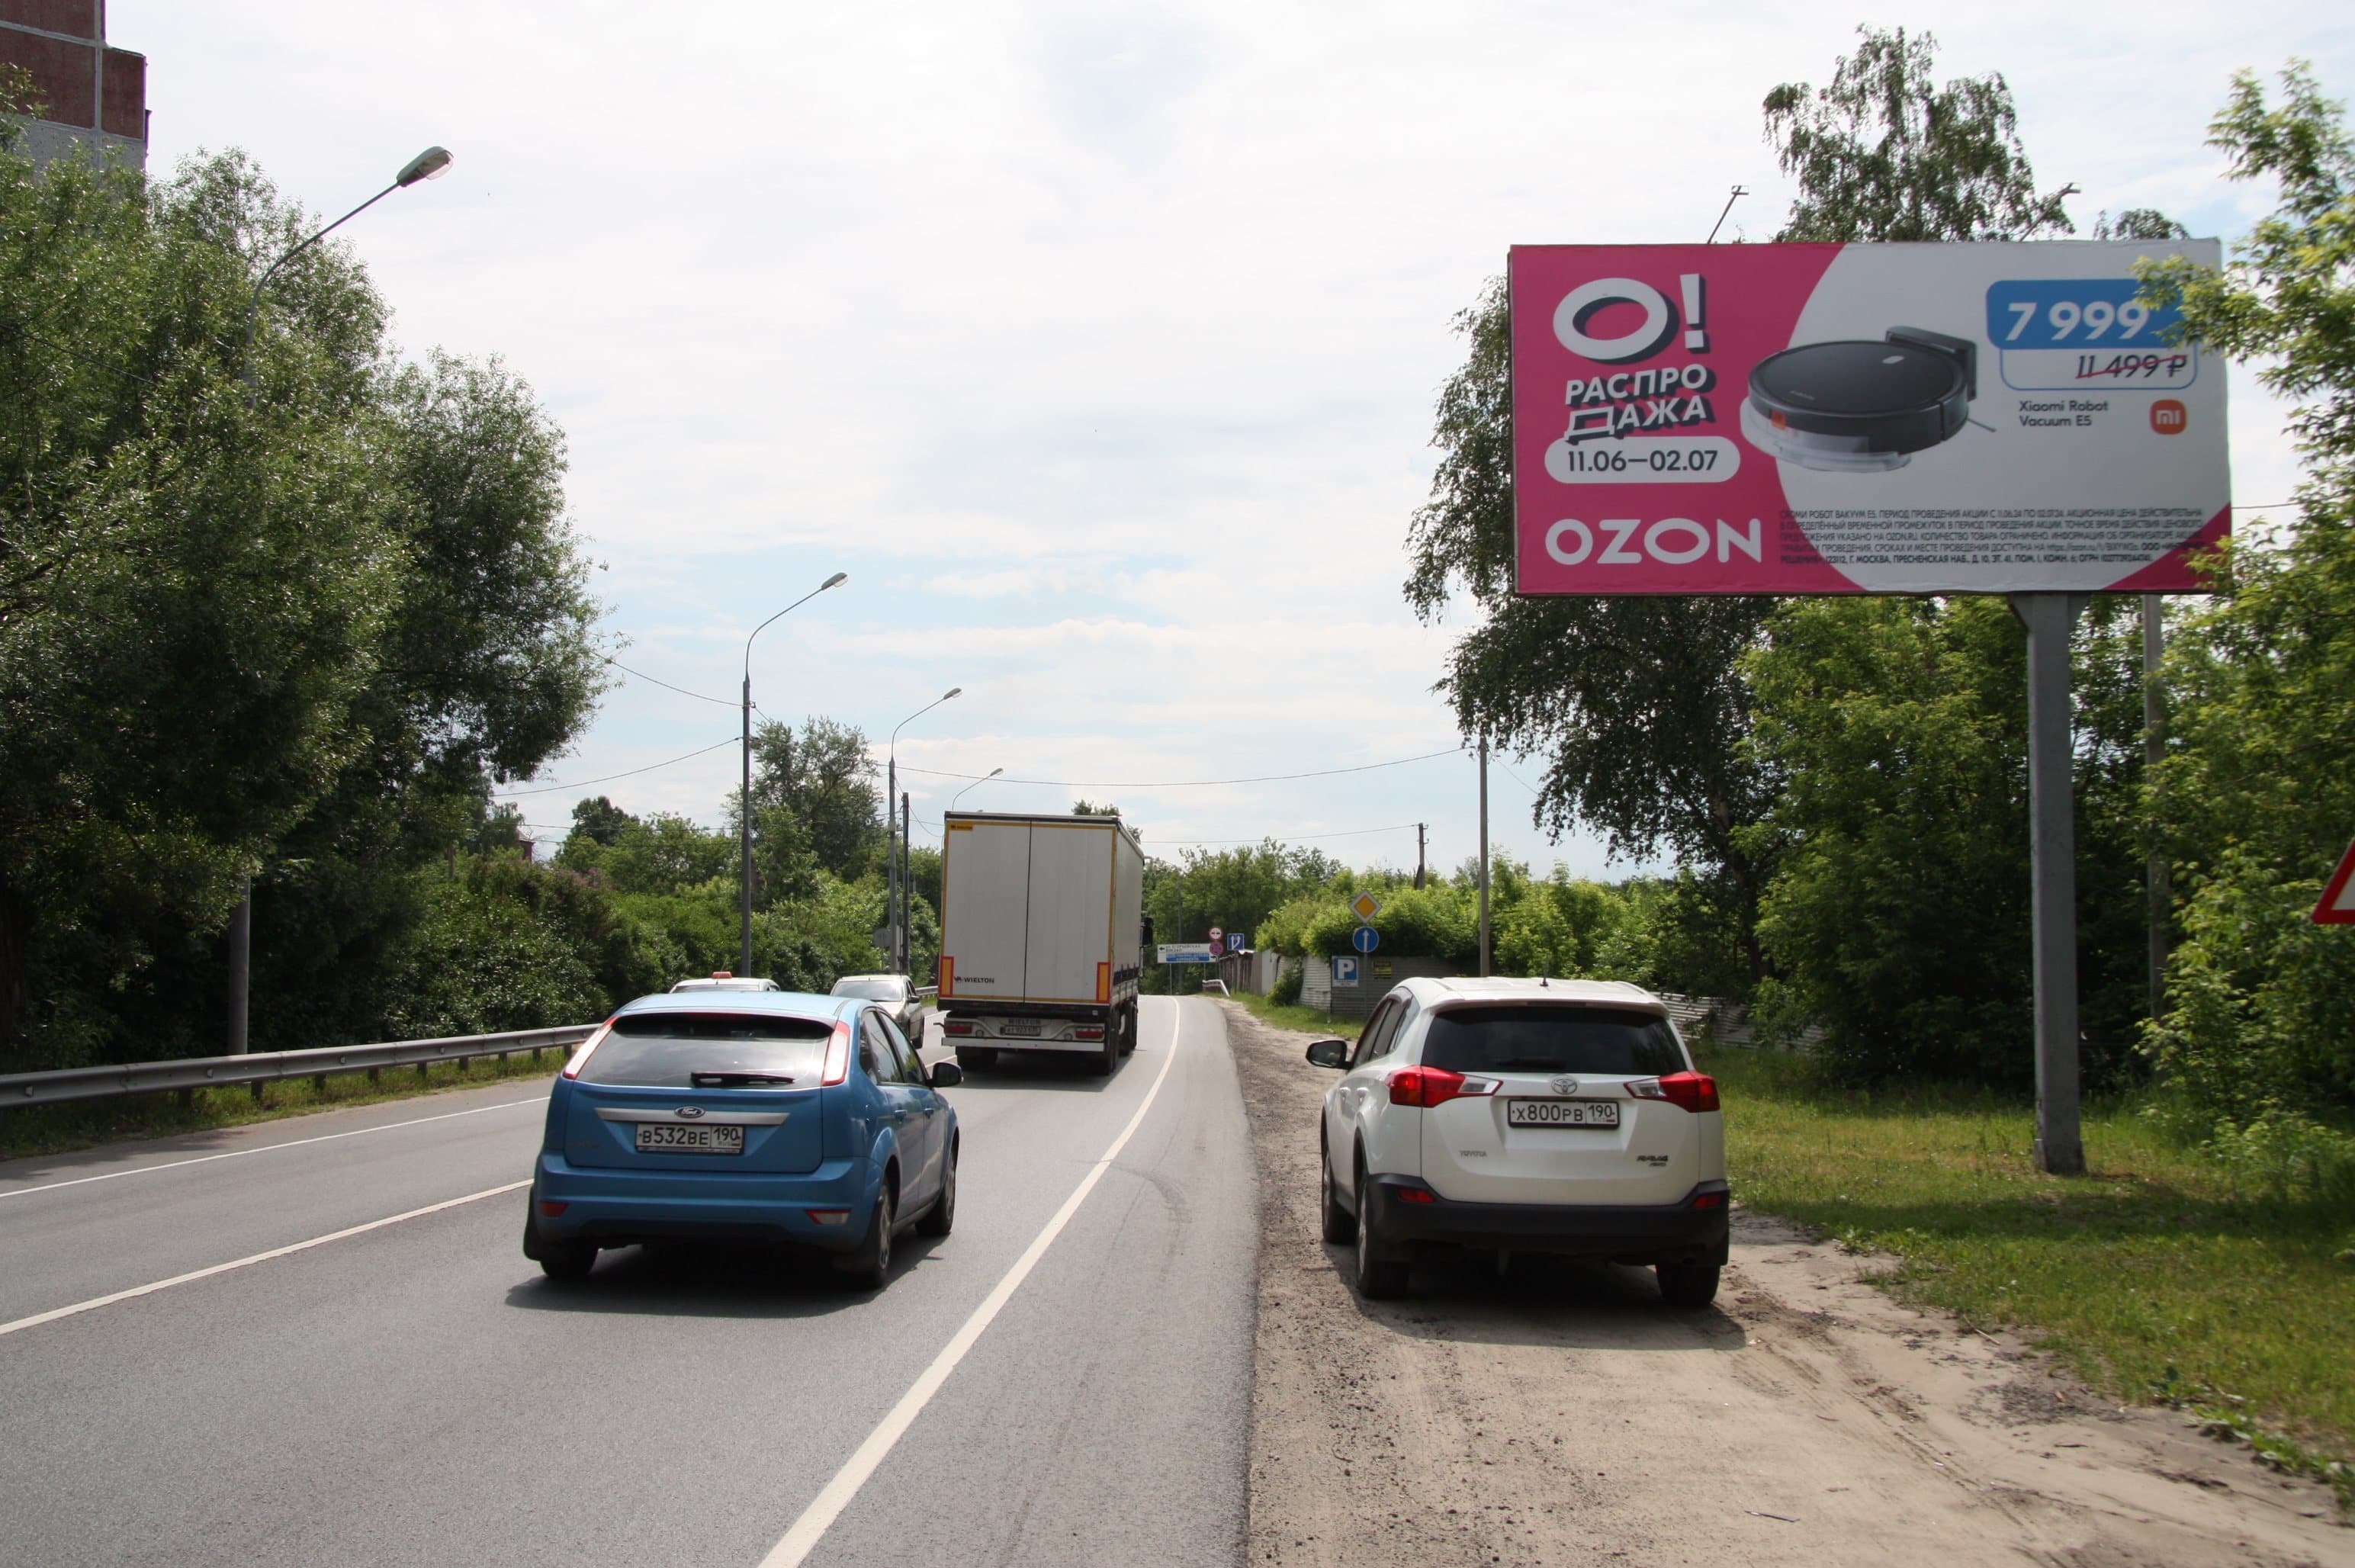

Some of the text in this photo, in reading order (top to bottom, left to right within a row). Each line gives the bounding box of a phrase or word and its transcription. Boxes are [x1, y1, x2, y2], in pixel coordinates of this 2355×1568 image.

[1553, 273, 1708, 362] О!
[2048, 300, 2149, 341] 999
[2106, 353, 2161, 378] 499
[1565, 364, 1708, 406] РАСПРО
[2019, 400, 2109, 413] Xiaomi Robot
[1564, 395, 1708, 442] ДАЖА
[2019, 415, 2093, 427] Vacuum E5
[1809, 510, 1833, 519] РОБОТ
[1836, 510, 1865, 519] ВАКУУМ
[1879, 509, 1910, 519] ПЕРИОД
[1911, 509, 1960, 519] ПРОВЕДЕНИЯ
[1961, 509, 1988, 518] АКЦИИ
[2024, 509, 2035, 518] ПО
[1848, 521, 1893, 530] ВРЕМЕННОЙ
[1894, 521, 1946, 529] ПРОМЕЖУТОК
[1955, 521, 1984, 529] ПЕРИОД
[1986, 520, 2033, 529] ПРОВЕДЕНИЯ
[1545, 518, 1763, 566] OZON
[1838, 532, 1871, 541] УКАЗАНО
[1874, 532, 1884, 541] НА
[1921, 532, 1969, 541] КОЛИЧЕСТВО
[1971, 532, 1998, 540] ТОВАРА
[1875, 544, 1905, 552] СРОКАХ
[1907, 544, 1913, 552] И
[1914, 544, 1939, 552] МЕСТЕ
[1940, 543, 1989, 552] ПРОВЕДЕНИЯ
[1990, 543, 2032, 551] ДОСТУПНА
[2141, 542, 2160, 551] ООО
[1893, 554, 1949, 563] ПРЕСНЕНСКАЯ
[1588, 1104, 1613, 1117] 190
[713, 1127, 738, 1141] 190
